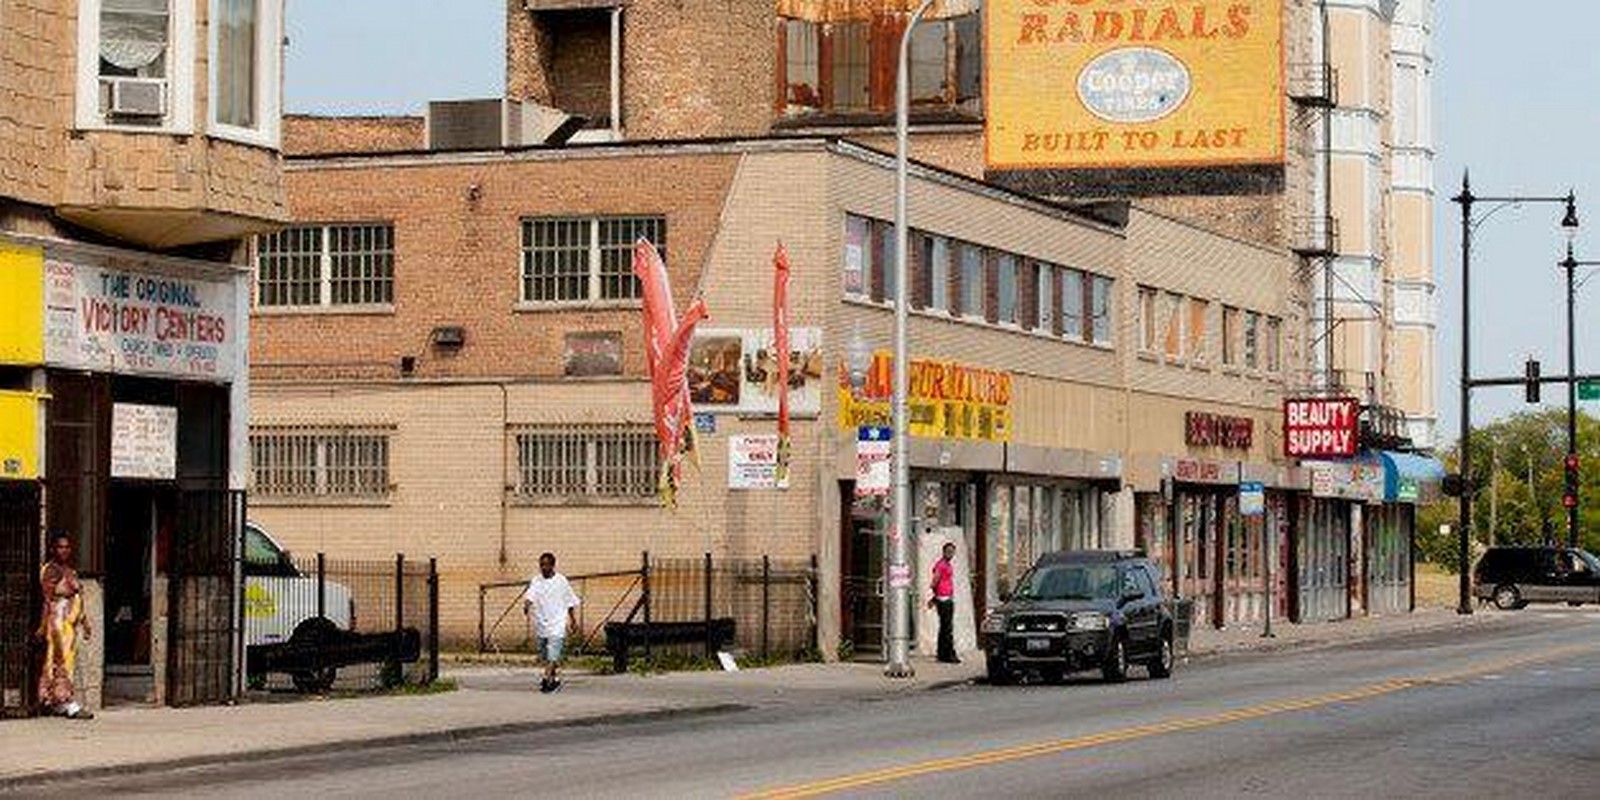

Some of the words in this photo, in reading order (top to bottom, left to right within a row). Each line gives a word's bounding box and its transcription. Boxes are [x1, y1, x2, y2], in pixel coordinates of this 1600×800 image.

[1017, 3, 1250, 44] RADIALS
[1088, 70, 1179, 95] Cooper
[1021, 130, 1110, 152] BUILT
[1122, 130, 1157, 151] TO
[1171, 127, 1249, 150] LAST
[100, 272, 130, 299] THE
[81, 296, 149, 334] VICTORY
[156, 306, 225, 343] CENTERS
[908, 359, 1010, 406] FURNITURE
[1286, 401, 1350, 426] BEAUTY
[1287, 429, 1350, 453] SUPPLY
